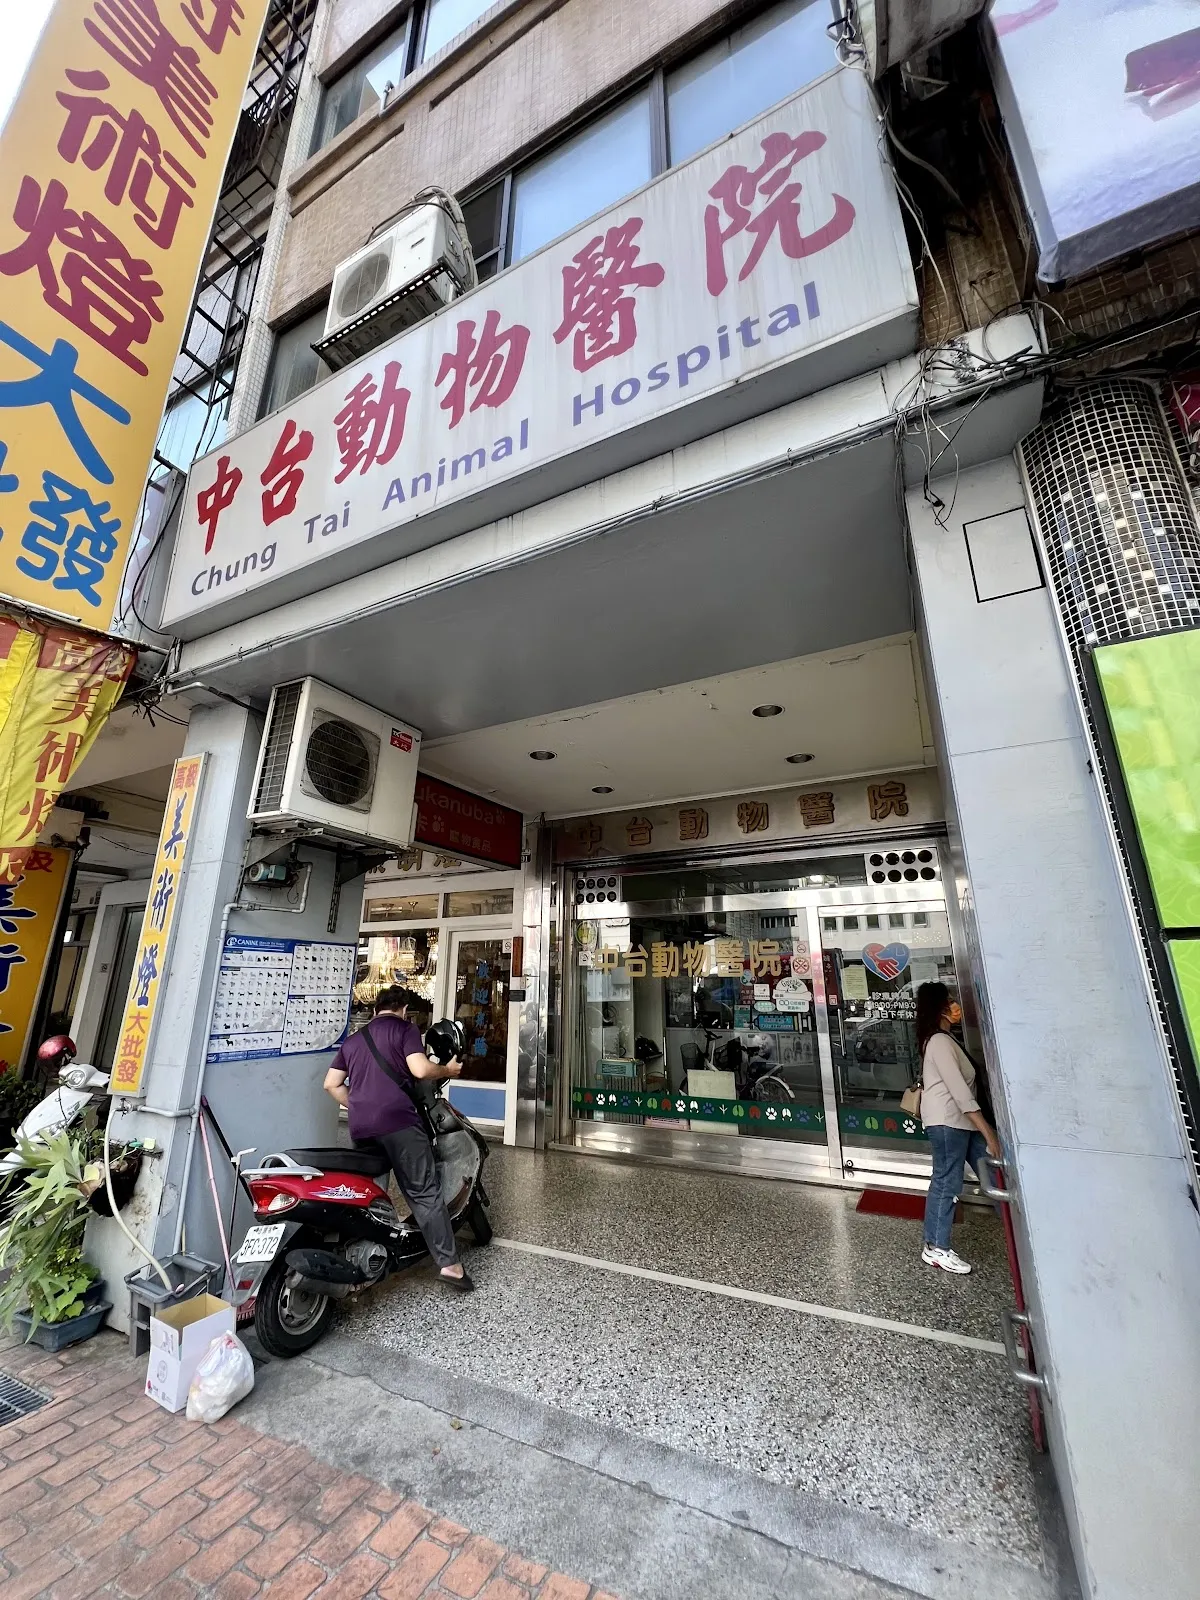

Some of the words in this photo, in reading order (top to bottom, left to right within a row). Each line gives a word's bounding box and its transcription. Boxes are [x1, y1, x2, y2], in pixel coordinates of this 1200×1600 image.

[197, 130, 856, 556] 中台動物醫院
[191, 542, 278, 596] Chung
[304, 501, 351, 544] Tai
[382, 418, 530, 511] Animal
[572, 281, 821, 427] Hospital
[173, 764, 197, 791] 高級
[576, 781, 909, 854] 中台動物醫院
[133, 791, 187, 1007] 美術燈
[594, 938, 783, 978] 中台動物醫院
[117, 1011, 149, 1084] 大批發
